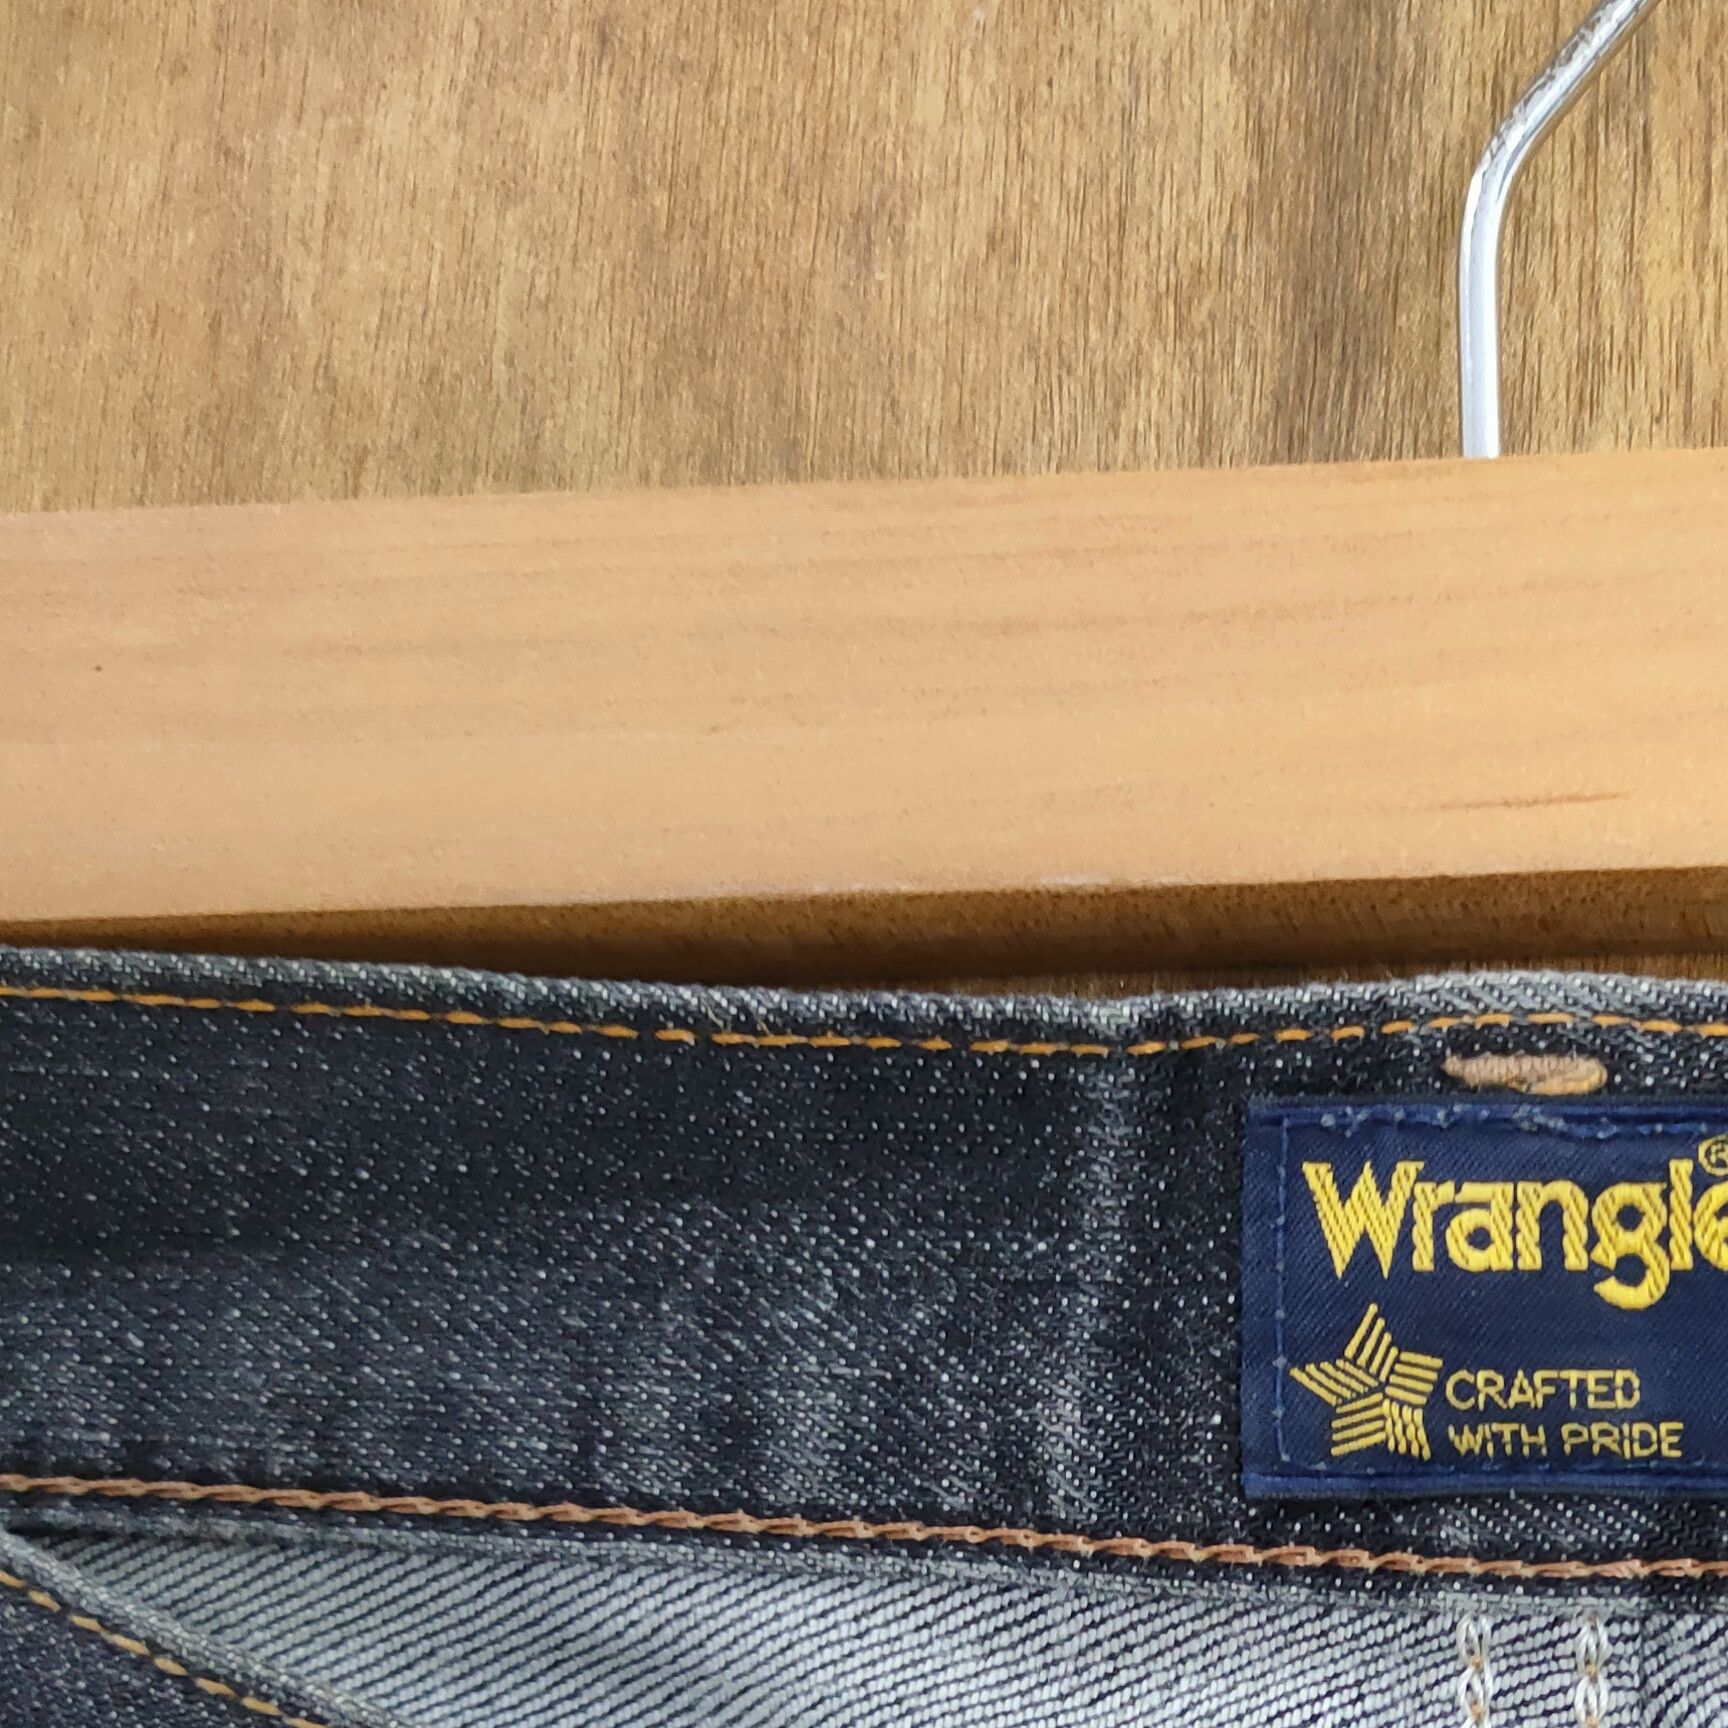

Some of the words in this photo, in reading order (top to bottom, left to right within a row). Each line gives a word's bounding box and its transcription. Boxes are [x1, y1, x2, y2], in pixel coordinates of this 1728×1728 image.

[1445, 1369, 1642, 1411] CRAFTED
[1447, 1422, 1547, 1459] WITH
[1561, 1421, 1685, 1458] PRIDE
